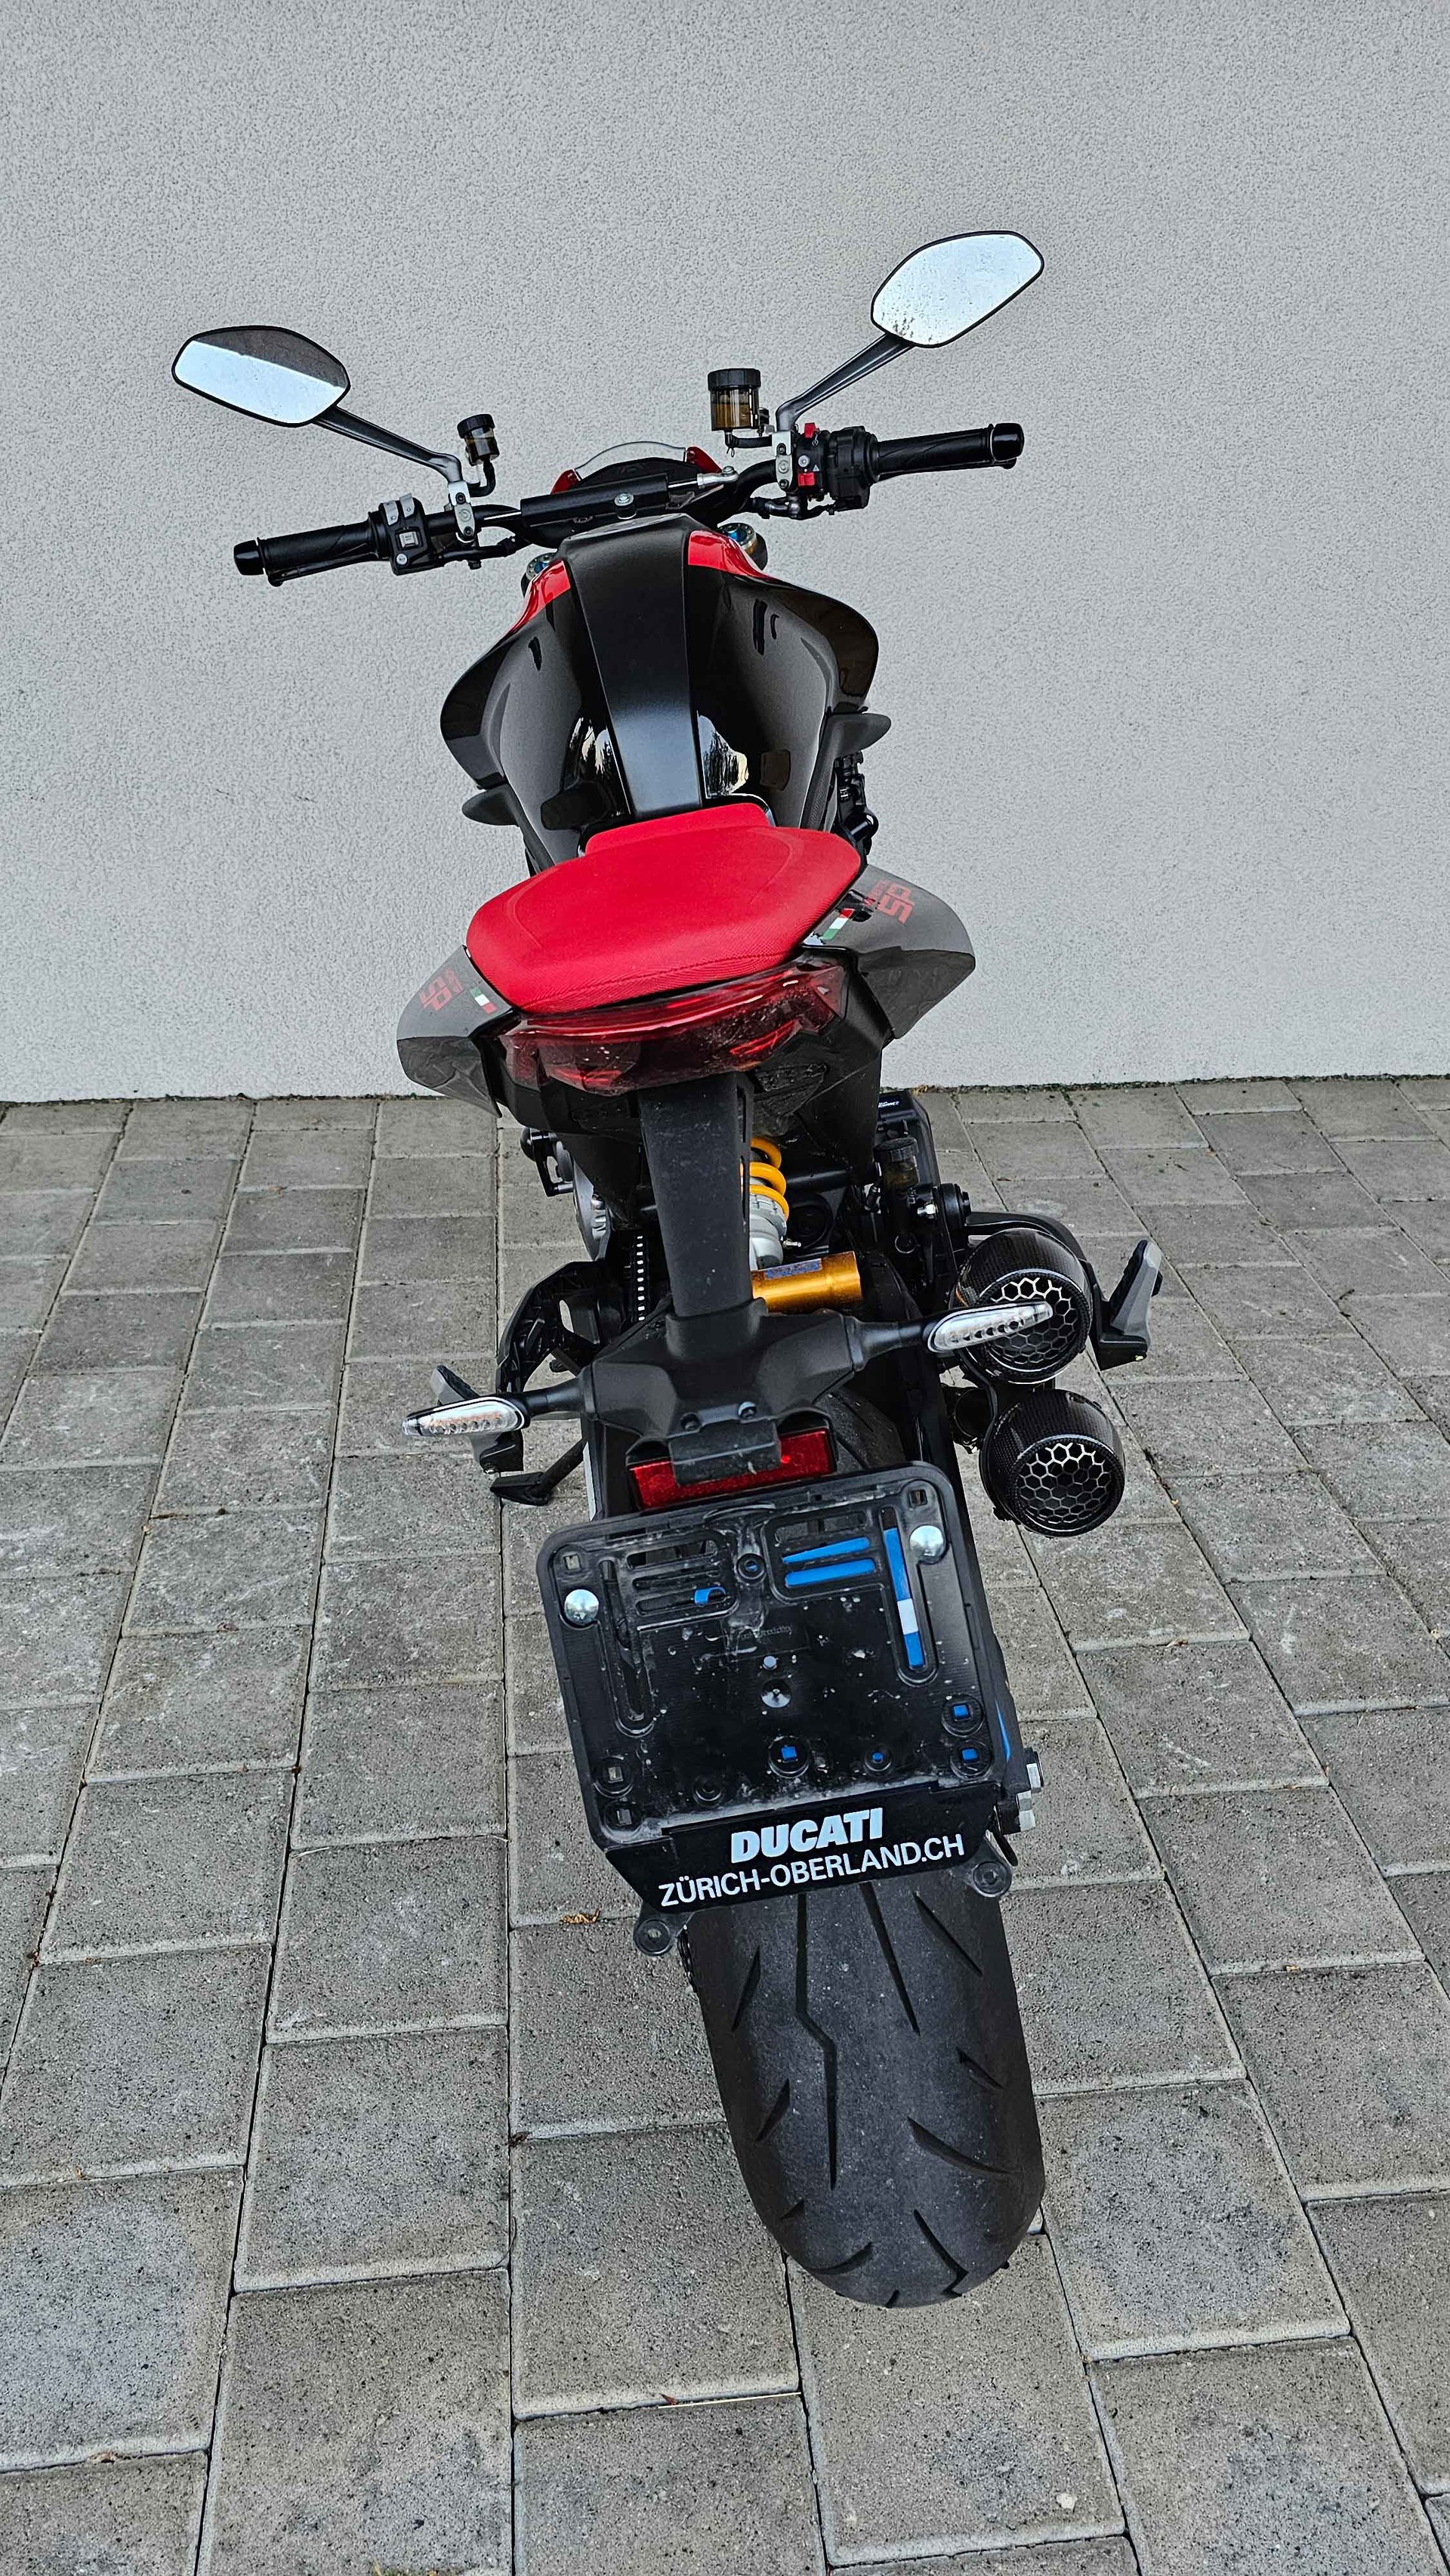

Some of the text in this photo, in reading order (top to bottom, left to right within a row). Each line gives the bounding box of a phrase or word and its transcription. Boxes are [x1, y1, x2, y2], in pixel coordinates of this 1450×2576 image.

[877, 882, 915, 925] SP
[731, 1808, 883, 1864] DUCATI
[659, 1834, 965, 1907] ZÜRICH-OBERLAND.CH
